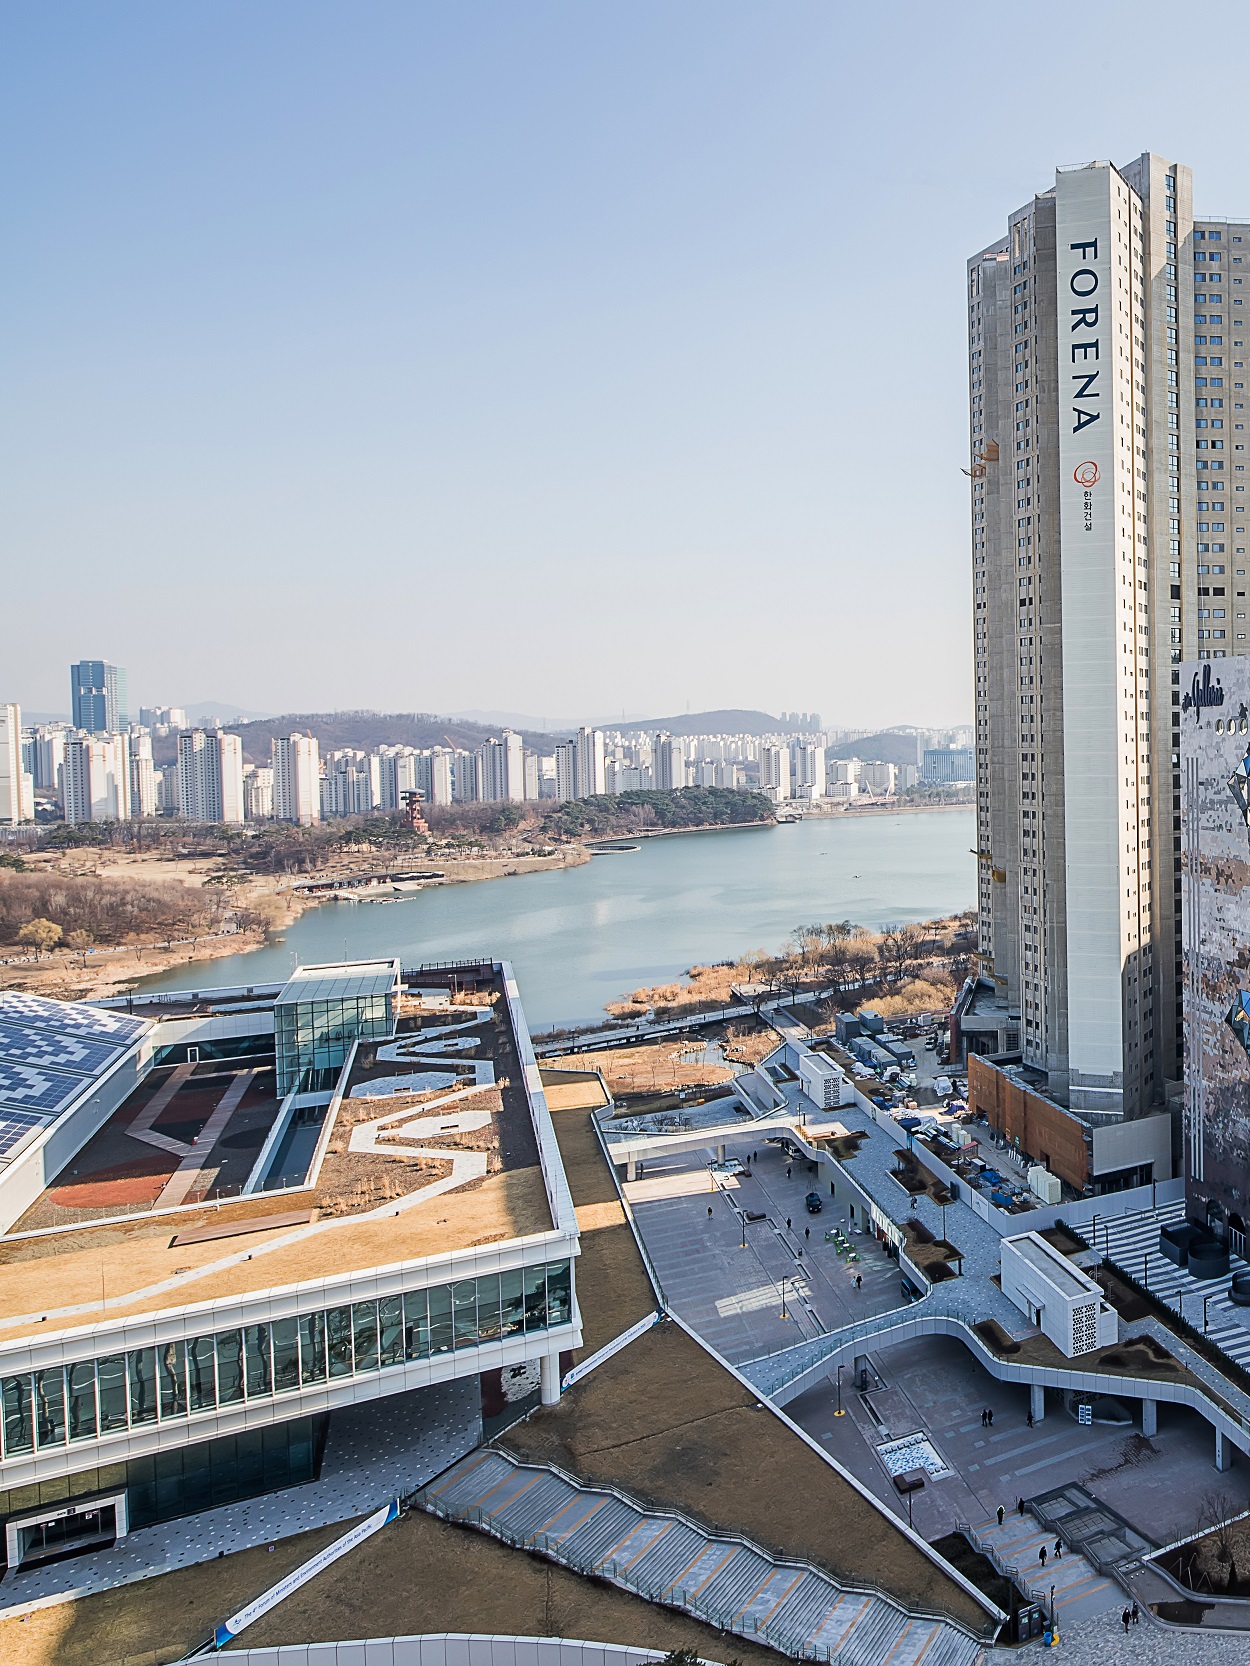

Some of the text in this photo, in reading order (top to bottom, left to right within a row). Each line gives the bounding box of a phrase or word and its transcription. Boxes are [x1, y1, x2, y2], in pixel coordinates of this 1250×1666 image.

[1070, 237, 1101, 434] FORENA
[1083, 490, 1093, 532] 한화건설
[275, 1581, 292, 1596] Ministers
[292, 1575, 300, 1584] and
